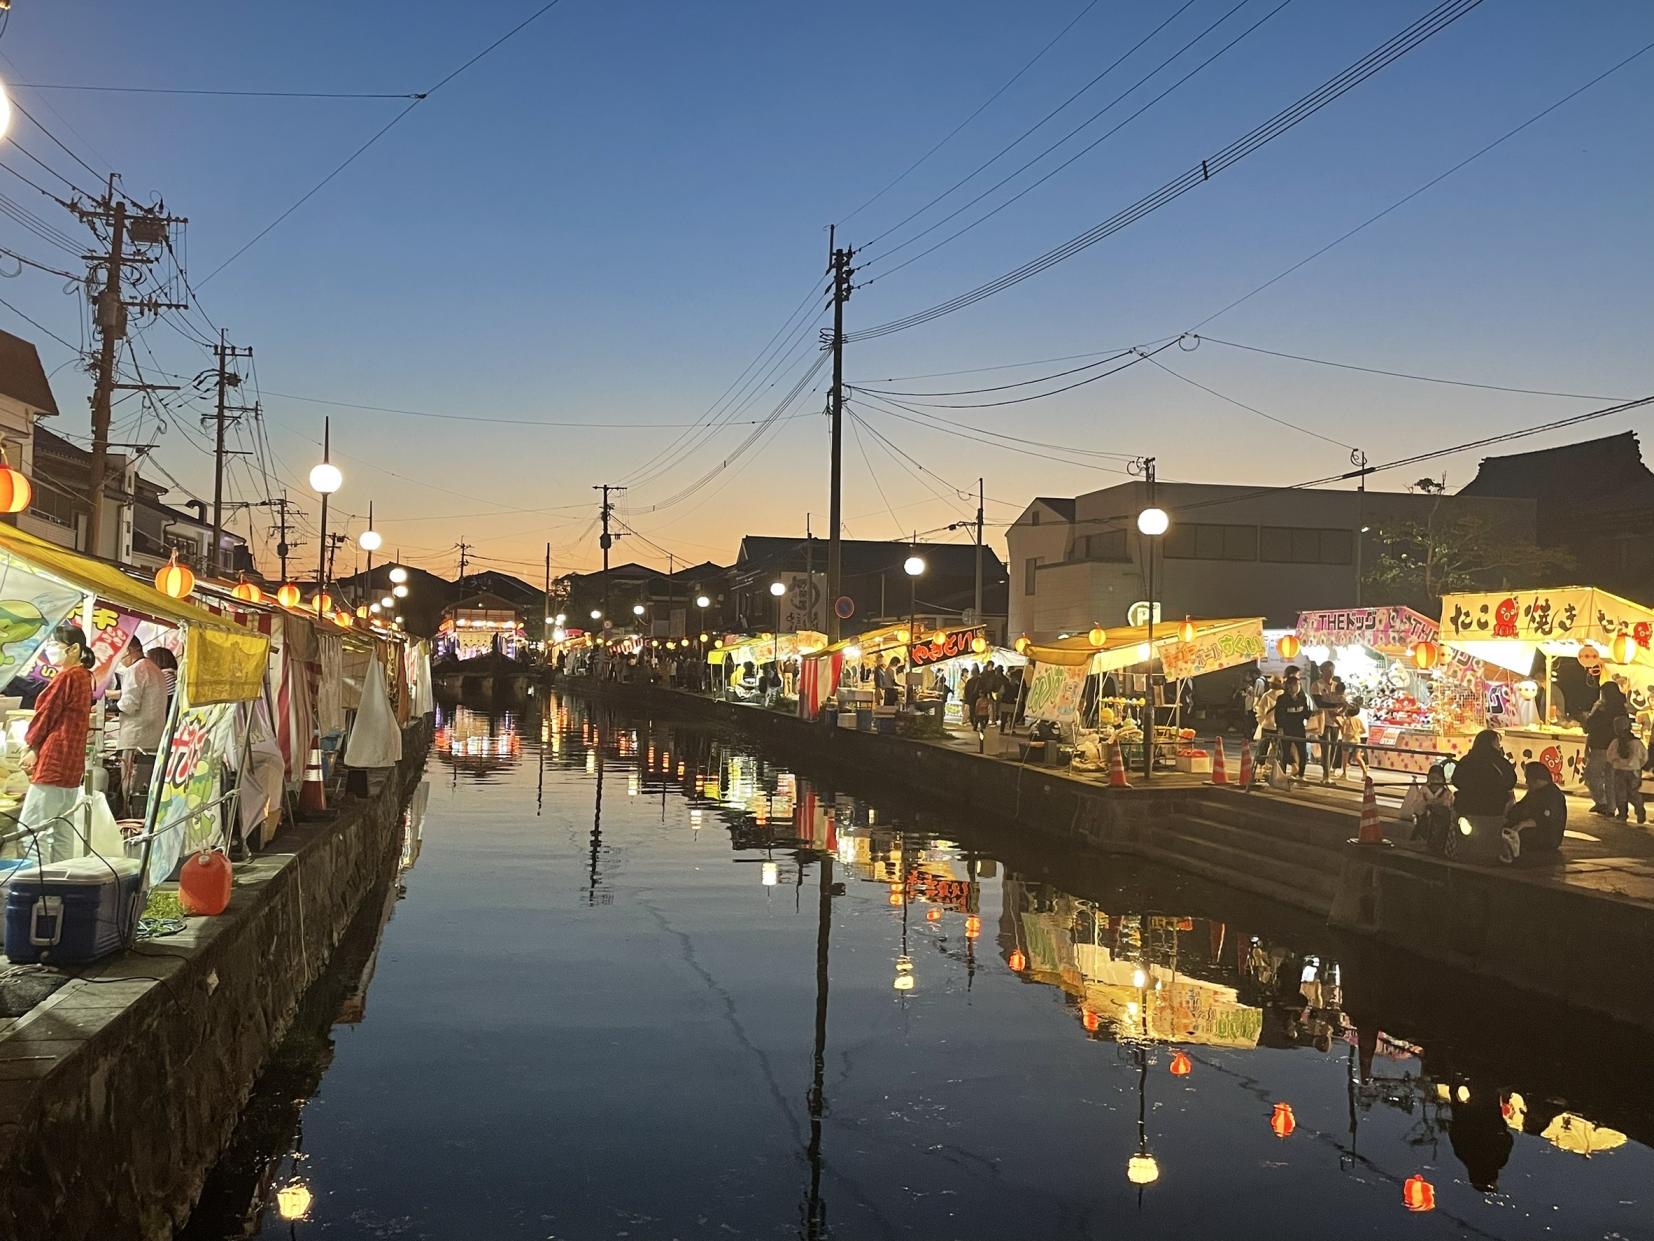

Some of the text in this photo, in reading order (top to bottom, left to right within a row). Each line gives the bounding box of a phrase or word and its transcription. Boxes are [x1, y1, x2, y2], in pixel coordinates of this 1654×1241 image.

[1319, 610, 1377, 631] THEドッグ
[1450, 596, 1577, 636] たこ焼き
